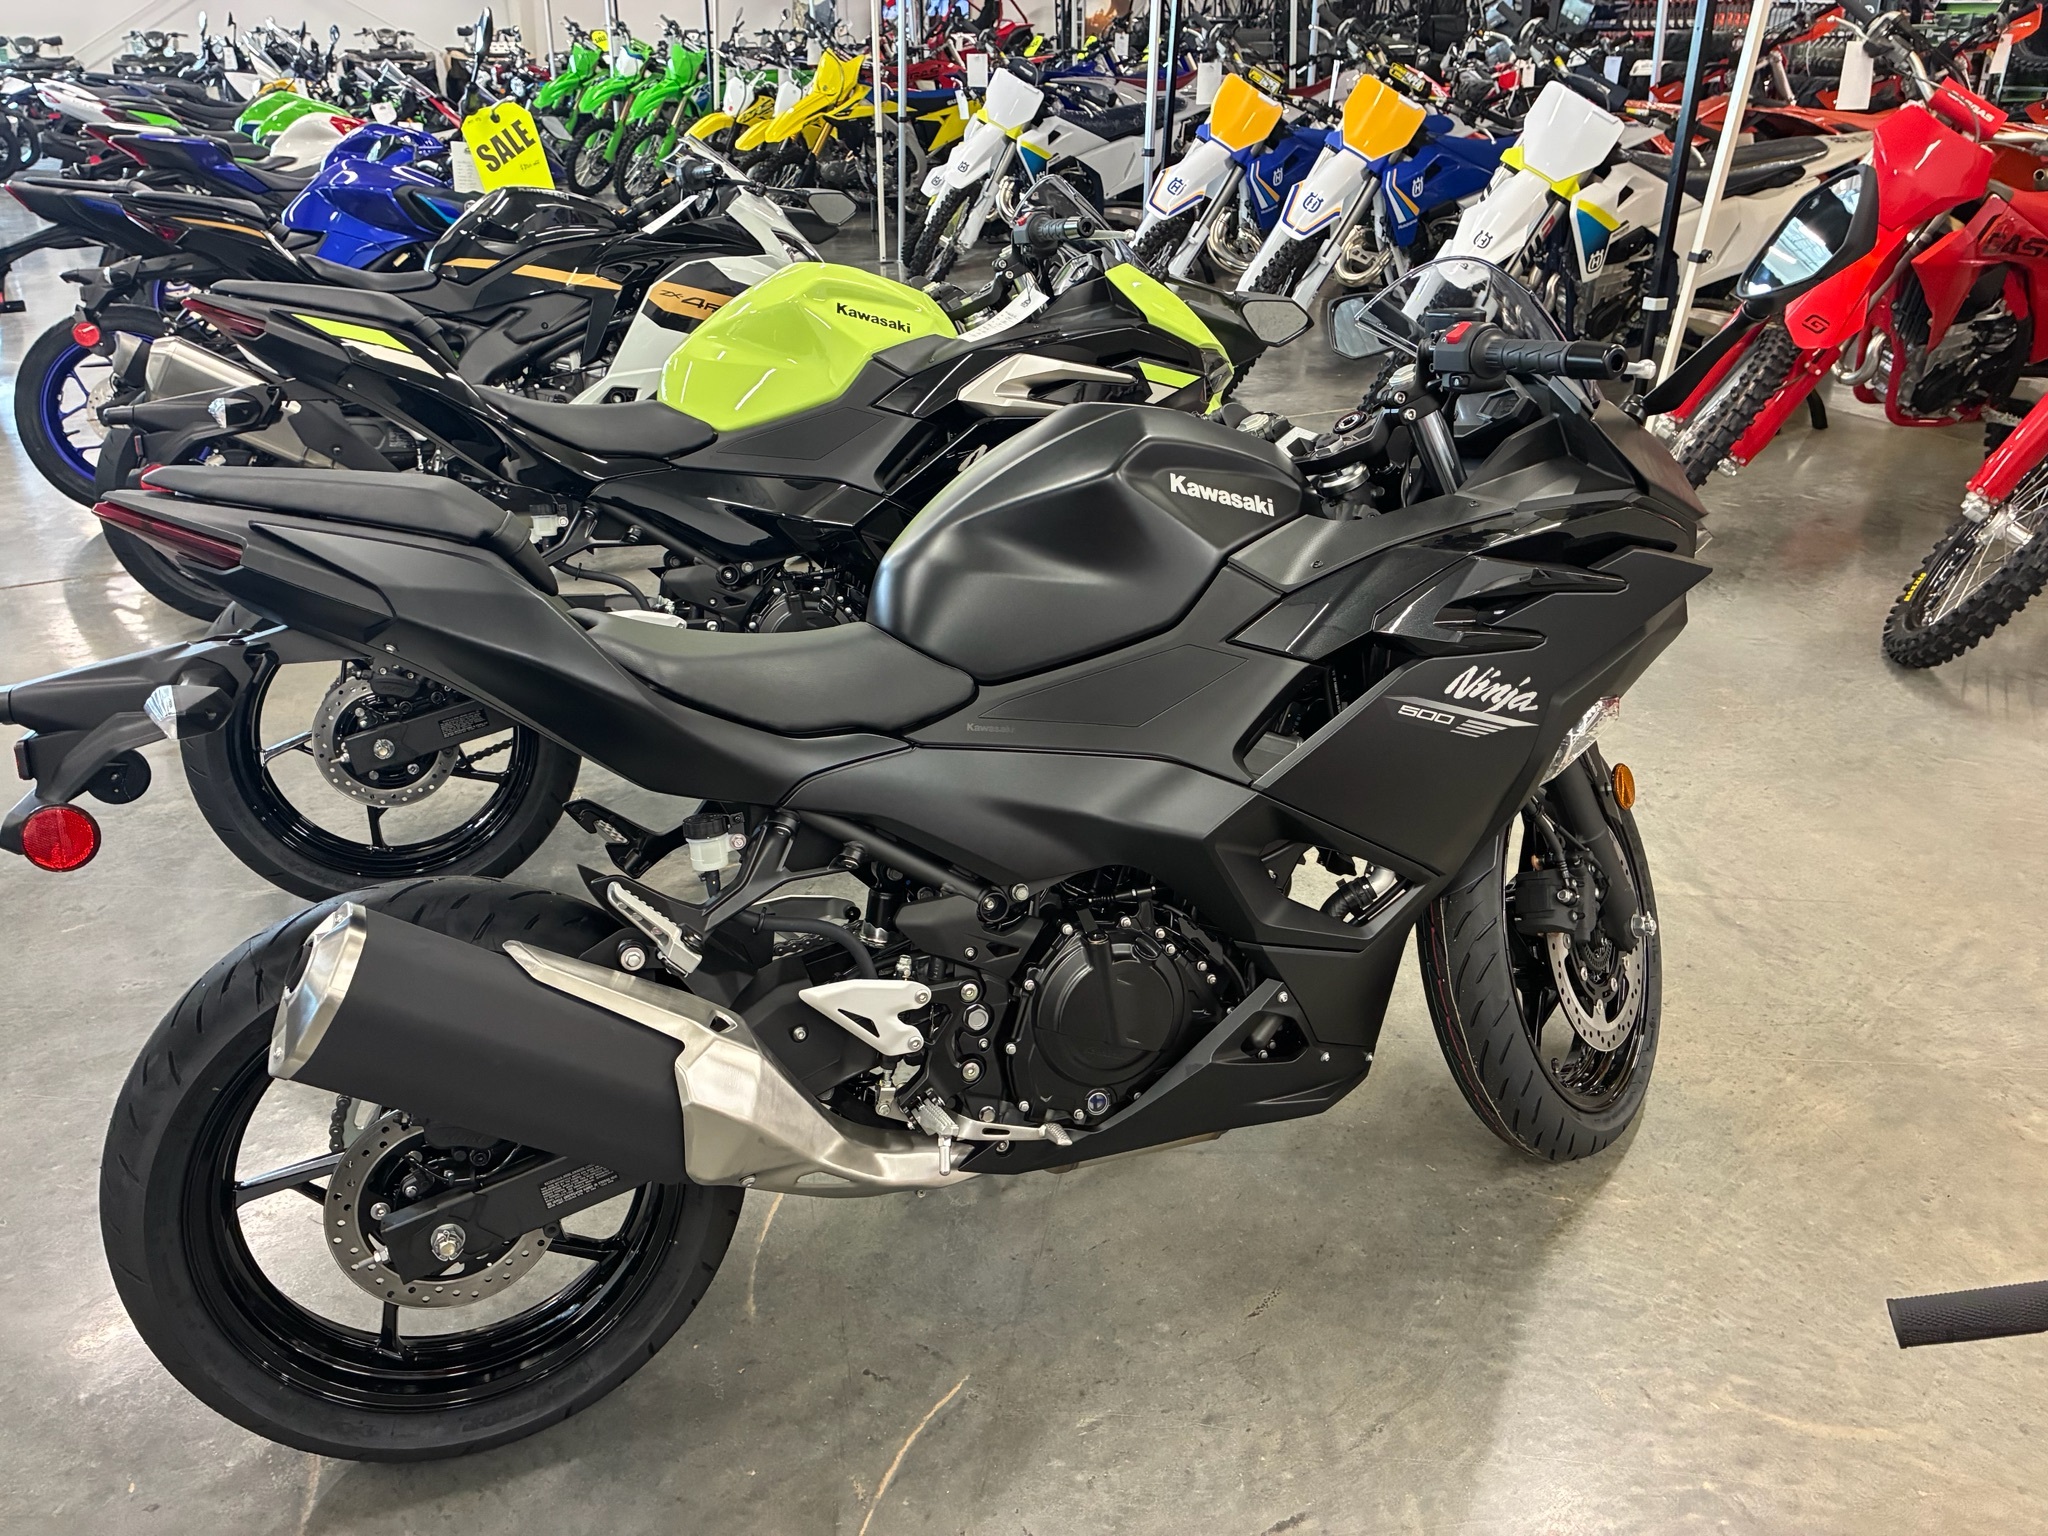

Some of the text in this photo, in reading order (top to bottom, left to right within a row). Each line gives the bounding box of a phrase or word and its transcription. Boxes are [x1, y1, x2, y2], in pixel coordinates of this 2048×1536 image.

[476, 119, 536, 172] SALE
[836, 302, 912, 335] Kawasaki
[1170, 472, 1275, 517] Kawasaki
[1444, 665, 1539, 713] Ninja
[1398, 705, 1456, 725] 500
